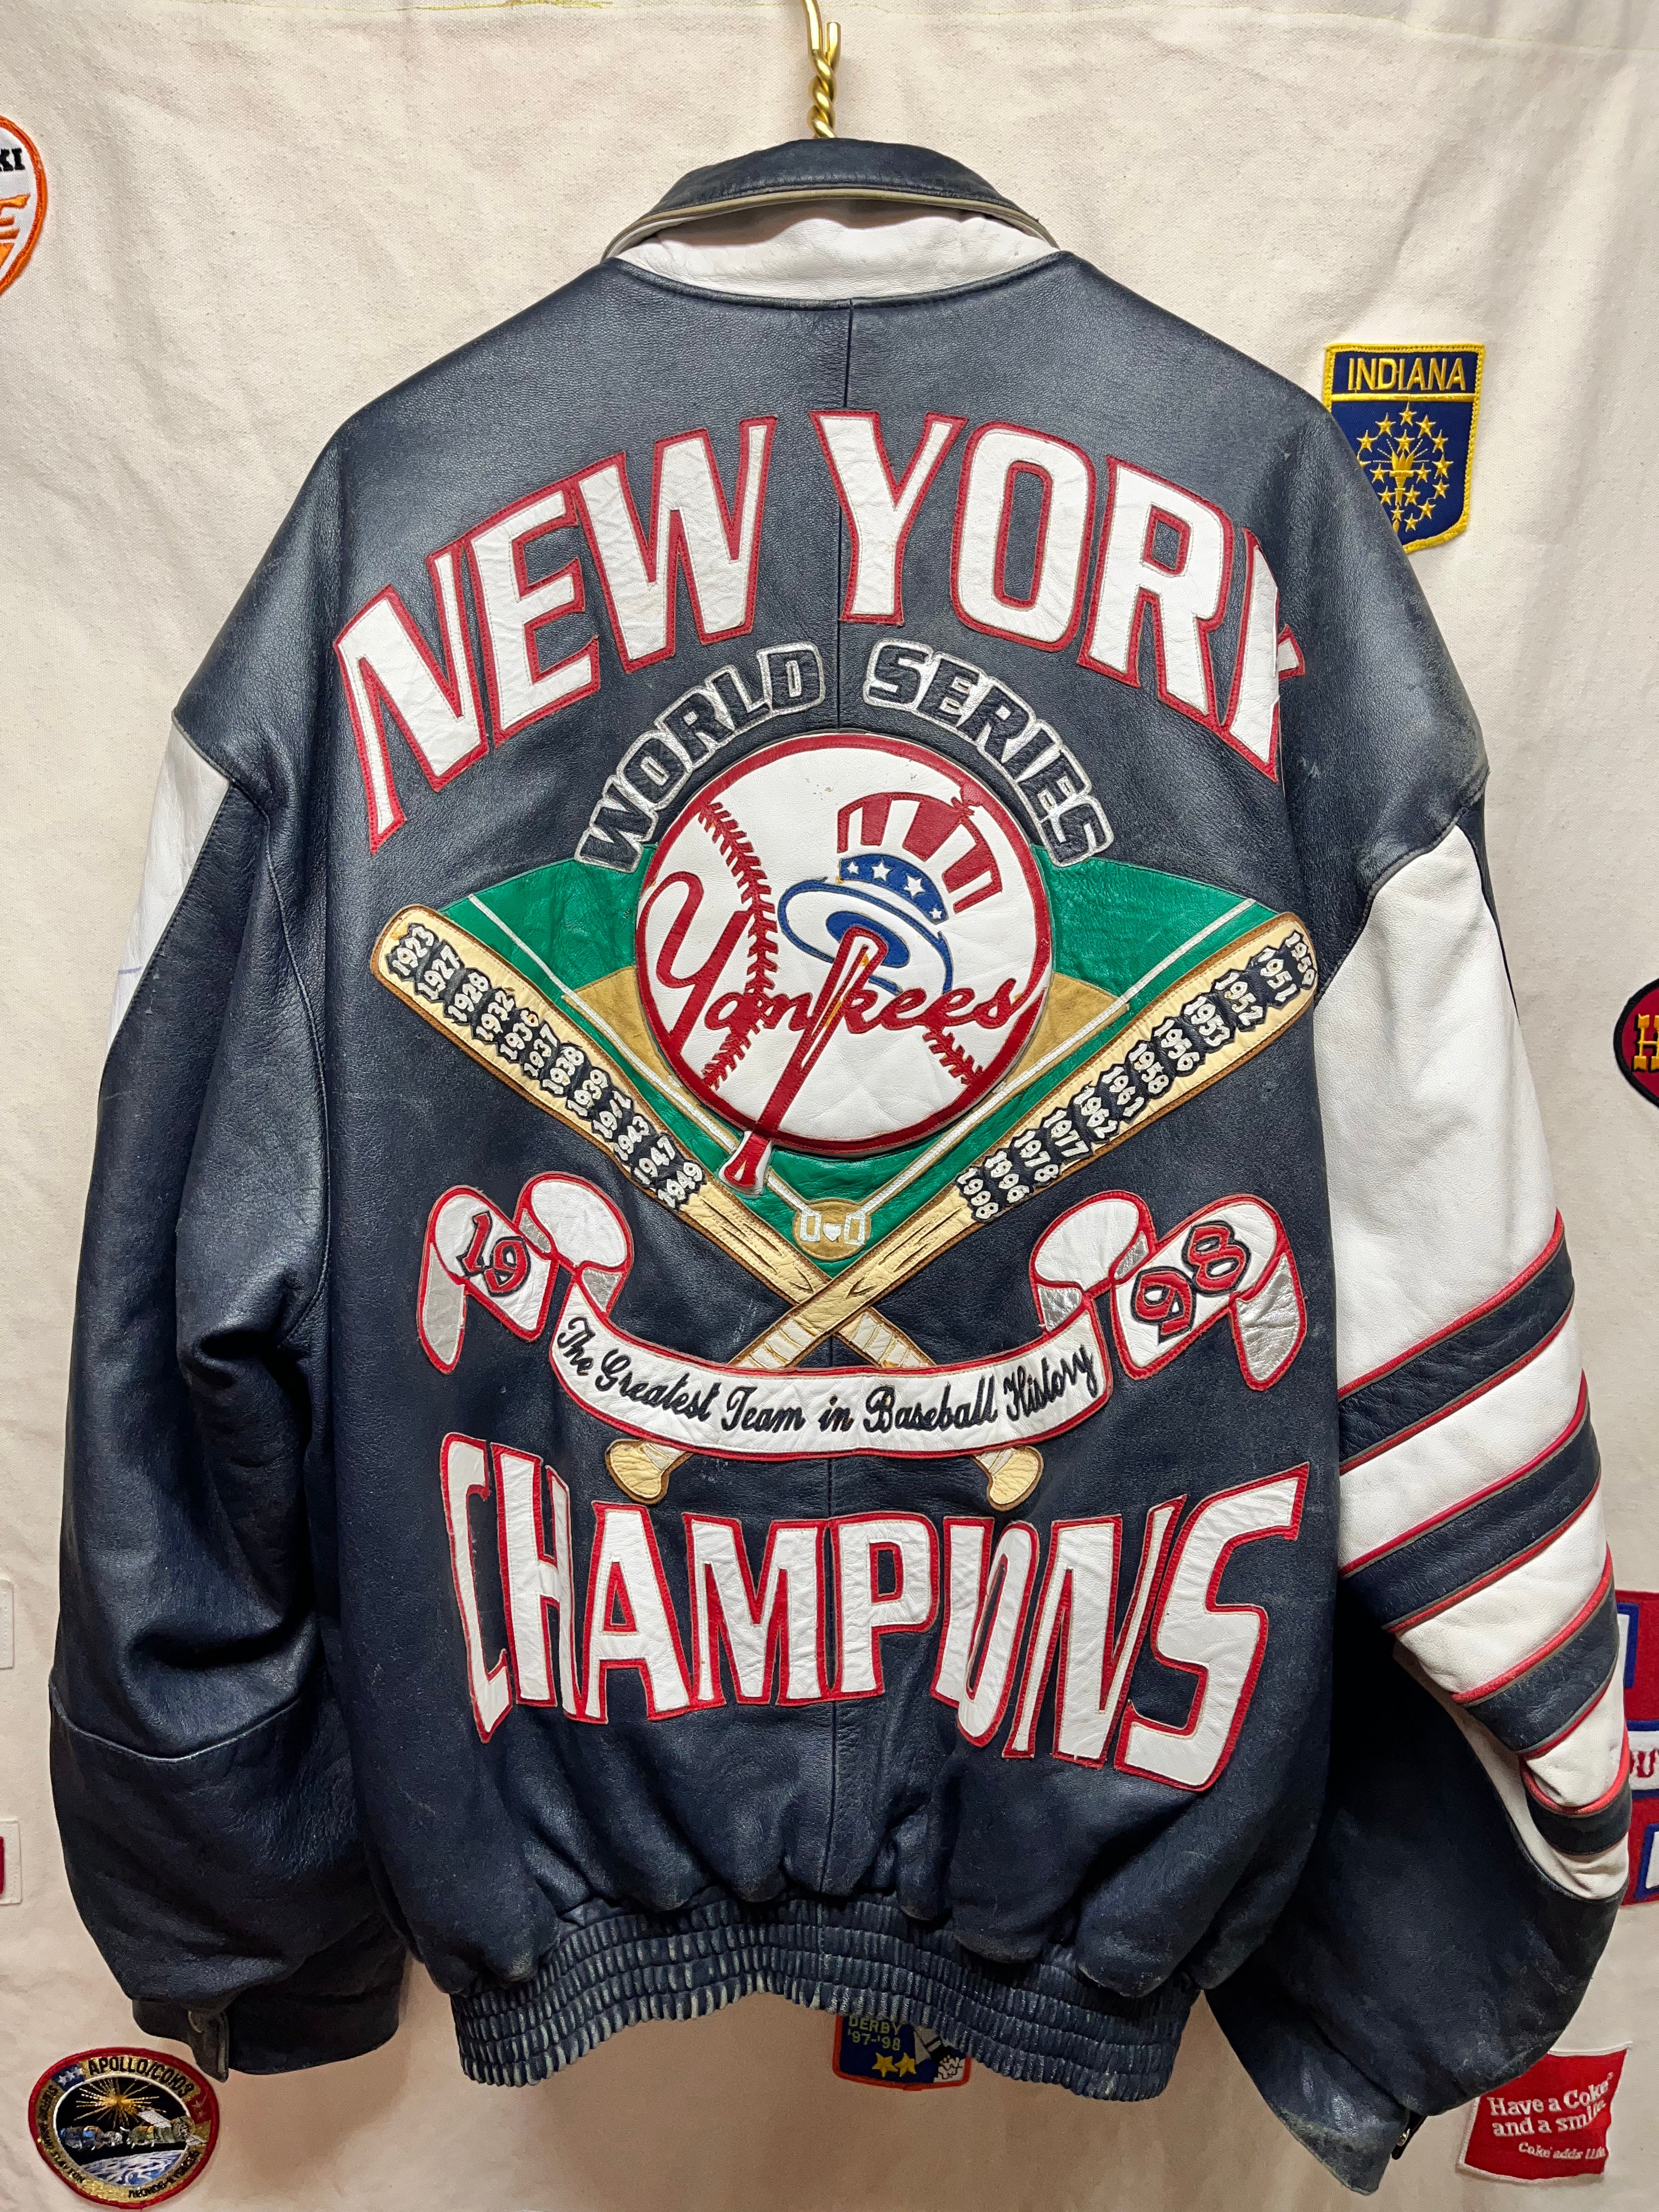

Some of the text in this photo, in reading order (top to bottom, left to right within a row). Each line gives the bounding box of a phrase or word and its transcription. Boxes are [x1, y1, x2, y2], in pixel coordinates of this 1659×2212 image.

[1348, 357, 1466, 391] INDIANA
[334, 414, 778, 854] NEW
[574, 639, 1114, 872] WORLD SERIES
[393, 927, 435, 976] 1923
[419, 947, 460, 999] 1927
[638, 871, 1022, 1051] Yankees
[1257, 947, 1298, 1002] 1951
[448, 974, 490, 1021] 1928
[476, 994, 515, 1040] 1932
[1185, 996, 1232, 1047] 1953
[1214, 972, 1263, 1026] 1952
[499, 1009, 539, 1061] 1936
[523, 1025, 560, 1076] 1937
[1155, 1020, 1201, 1070] 1956
[542, 1047, 585, 1094] 1938
[568, 1070, 608, 1115] 1939
[1102, 1066, 1145, 1115] 1961
[1128, 1043, 1170, 1094] 1958
[1044, 1110, 1091, 1158] 1977
[1075, 1086, 1119, 1139] 1962
[614, 1116, 651, 1161] 1943
[635, 1138, 676, 1183] 1947
[1015, 1130, 1059, 1182] 1978
[660, 1162, 703, 1206] 1949
[958, 1169, 999, 1219] 1998
[985, 1152, 1030, 1203] 1996
[456, 1211, 1251, 1345] 19 98
[557, 1317, 1098, 1434] The Greatest Team in Baseball History
[440, 1430, 1310, 1792] CHAMPIONS
[849, 2015, 903, 2035] DERBY
[1487, 2097, 1544, 2116] Have
[1548, 2098, 1562, 2112] a
[1492, 2117, 1535, 2136] and
[1538, 2119, 1552, 2134] a
[1553, 2148, 1583, 2160] adds
